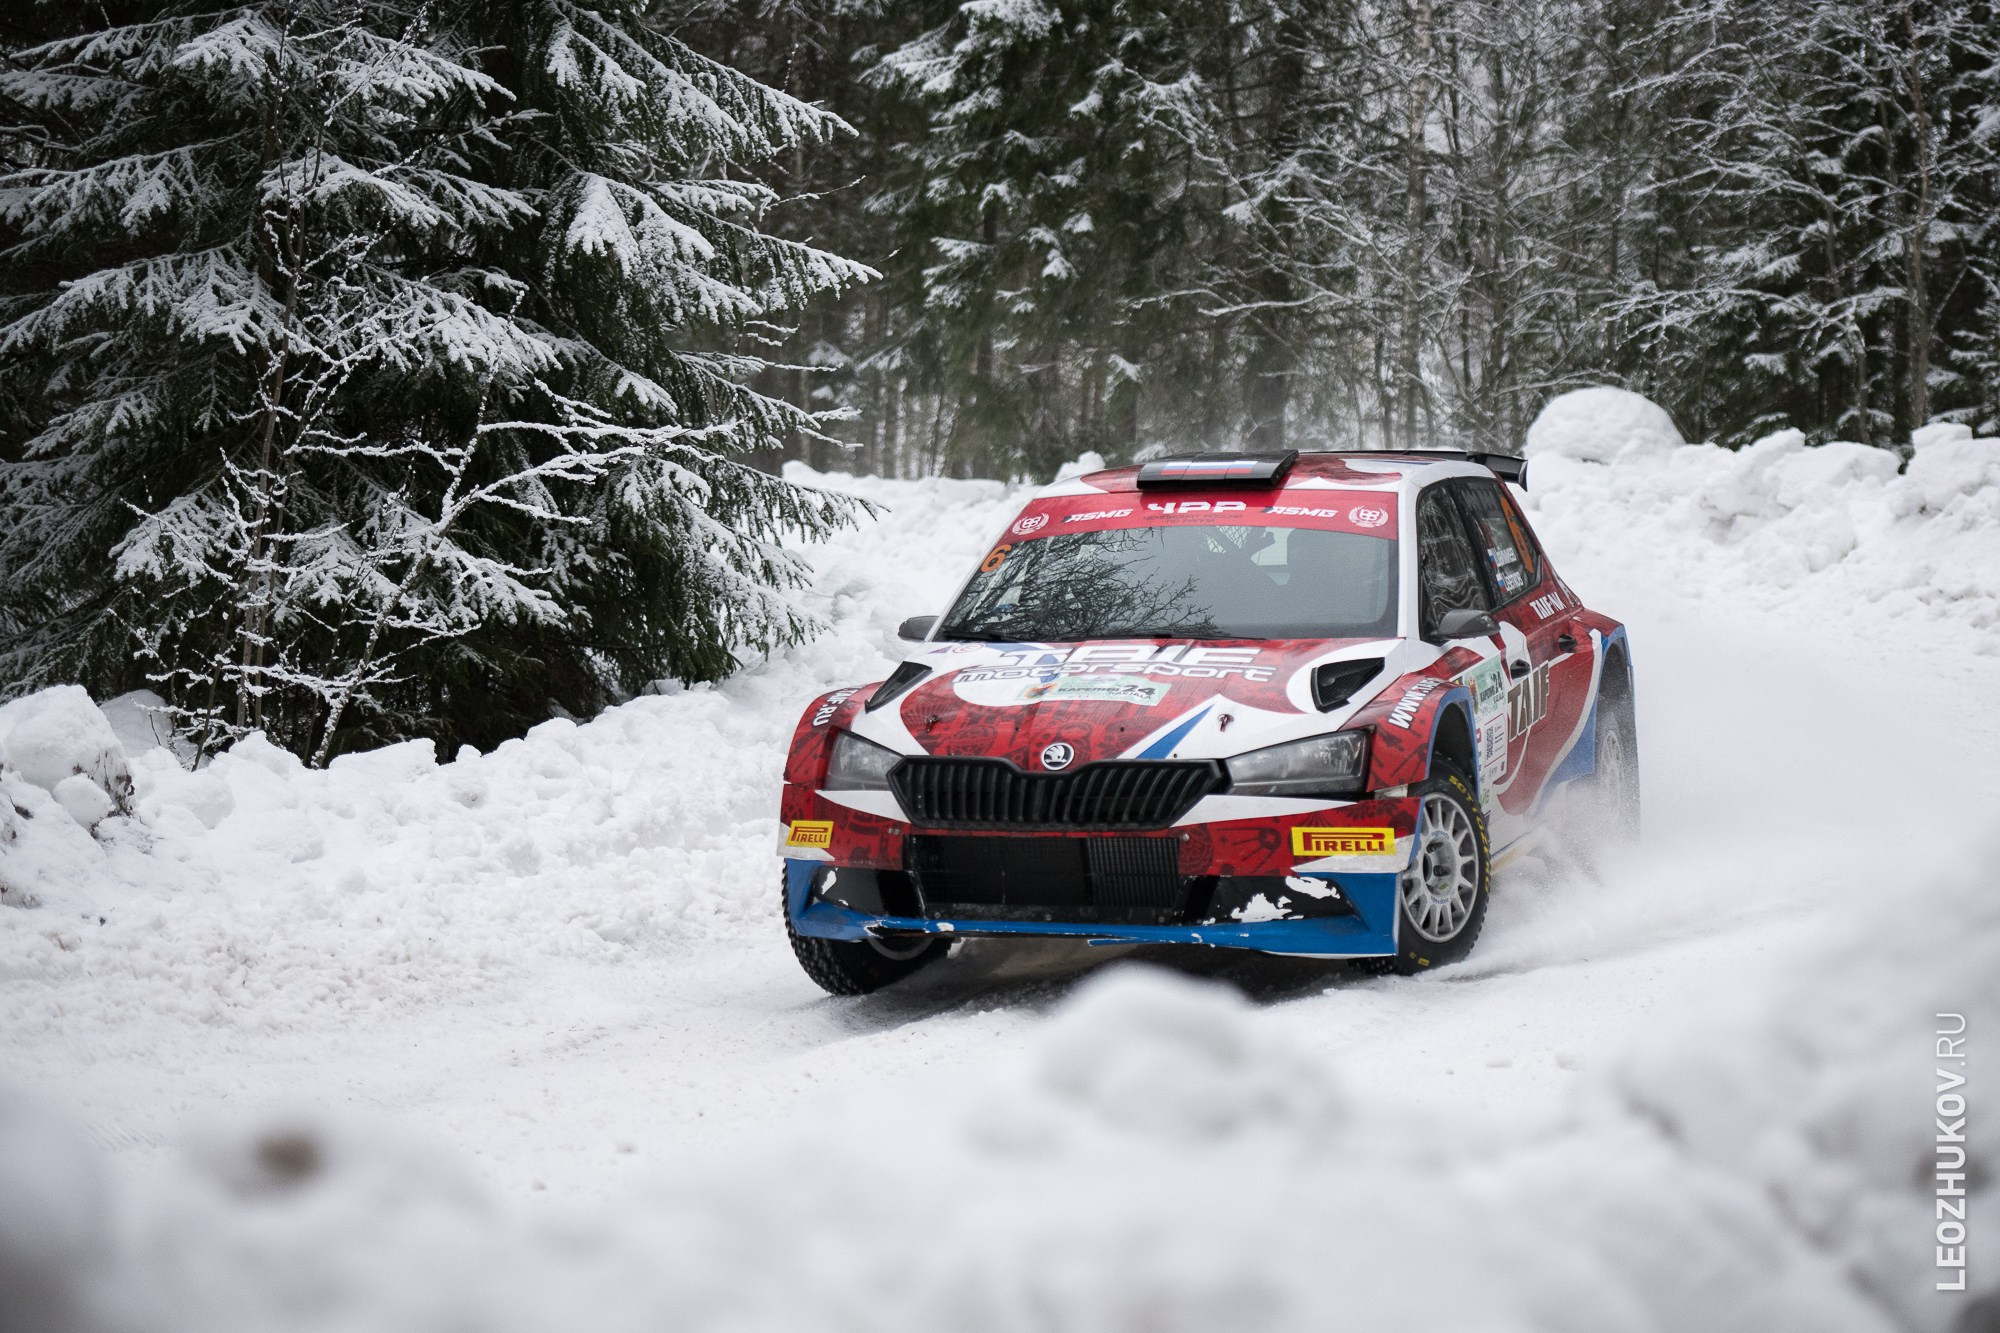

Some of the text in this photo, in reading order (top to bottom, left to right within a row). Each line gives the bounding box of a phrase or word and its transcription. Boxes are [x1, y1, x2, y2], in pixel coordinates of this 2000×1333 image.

[981, 544, 1012, 573] 6
[951, 660, 1278, 684] motorsport
[1507, 660, 1549, 743] TAIF
[791, 826, 829, 843] PIRELLI
[1302, 832, 1386, 851] PIRELLI
